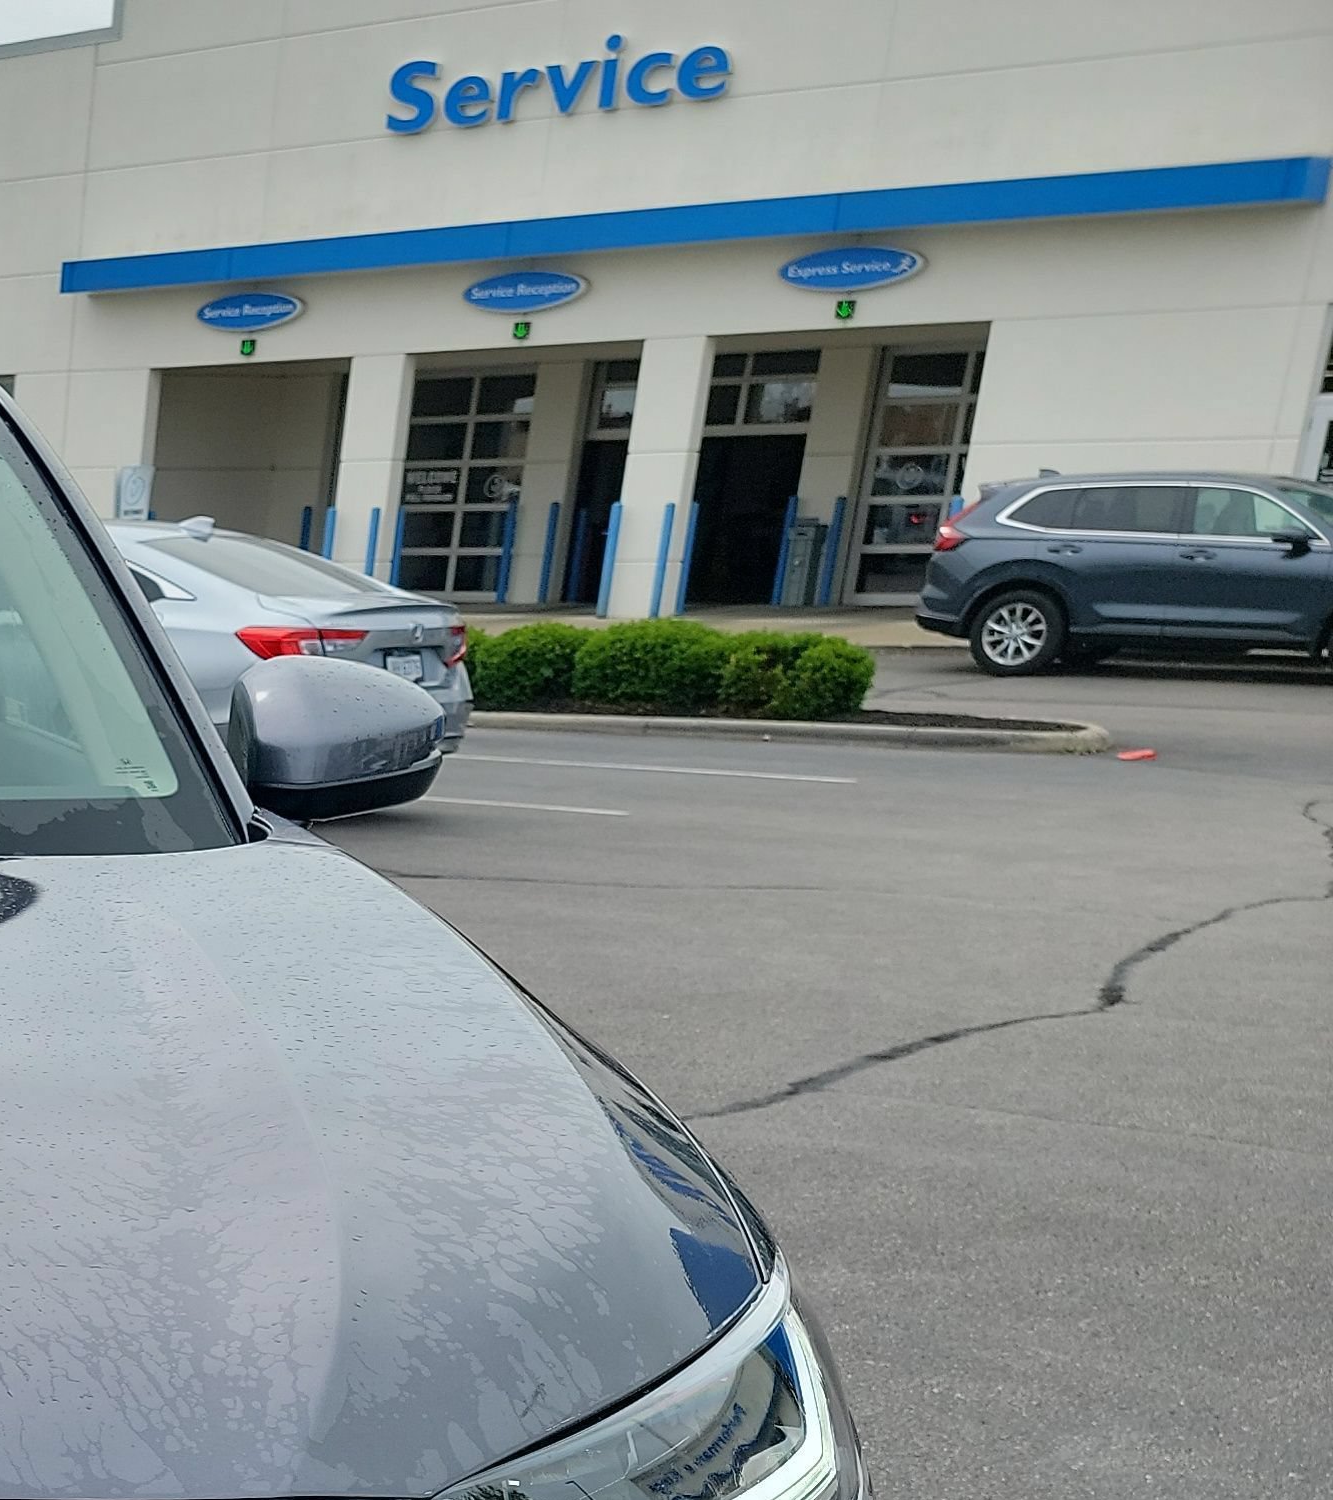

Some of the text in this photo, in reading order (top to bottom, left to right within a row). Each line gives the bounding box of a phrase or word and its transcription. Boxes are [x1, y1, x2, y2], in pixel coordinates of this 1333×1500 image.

[385, 33, 731, 135] Service
[787, 260, 891, 279] Express Service
[470, 282, 577, 300] Service Reception
[201, 303, 294, 319] Service Reception
